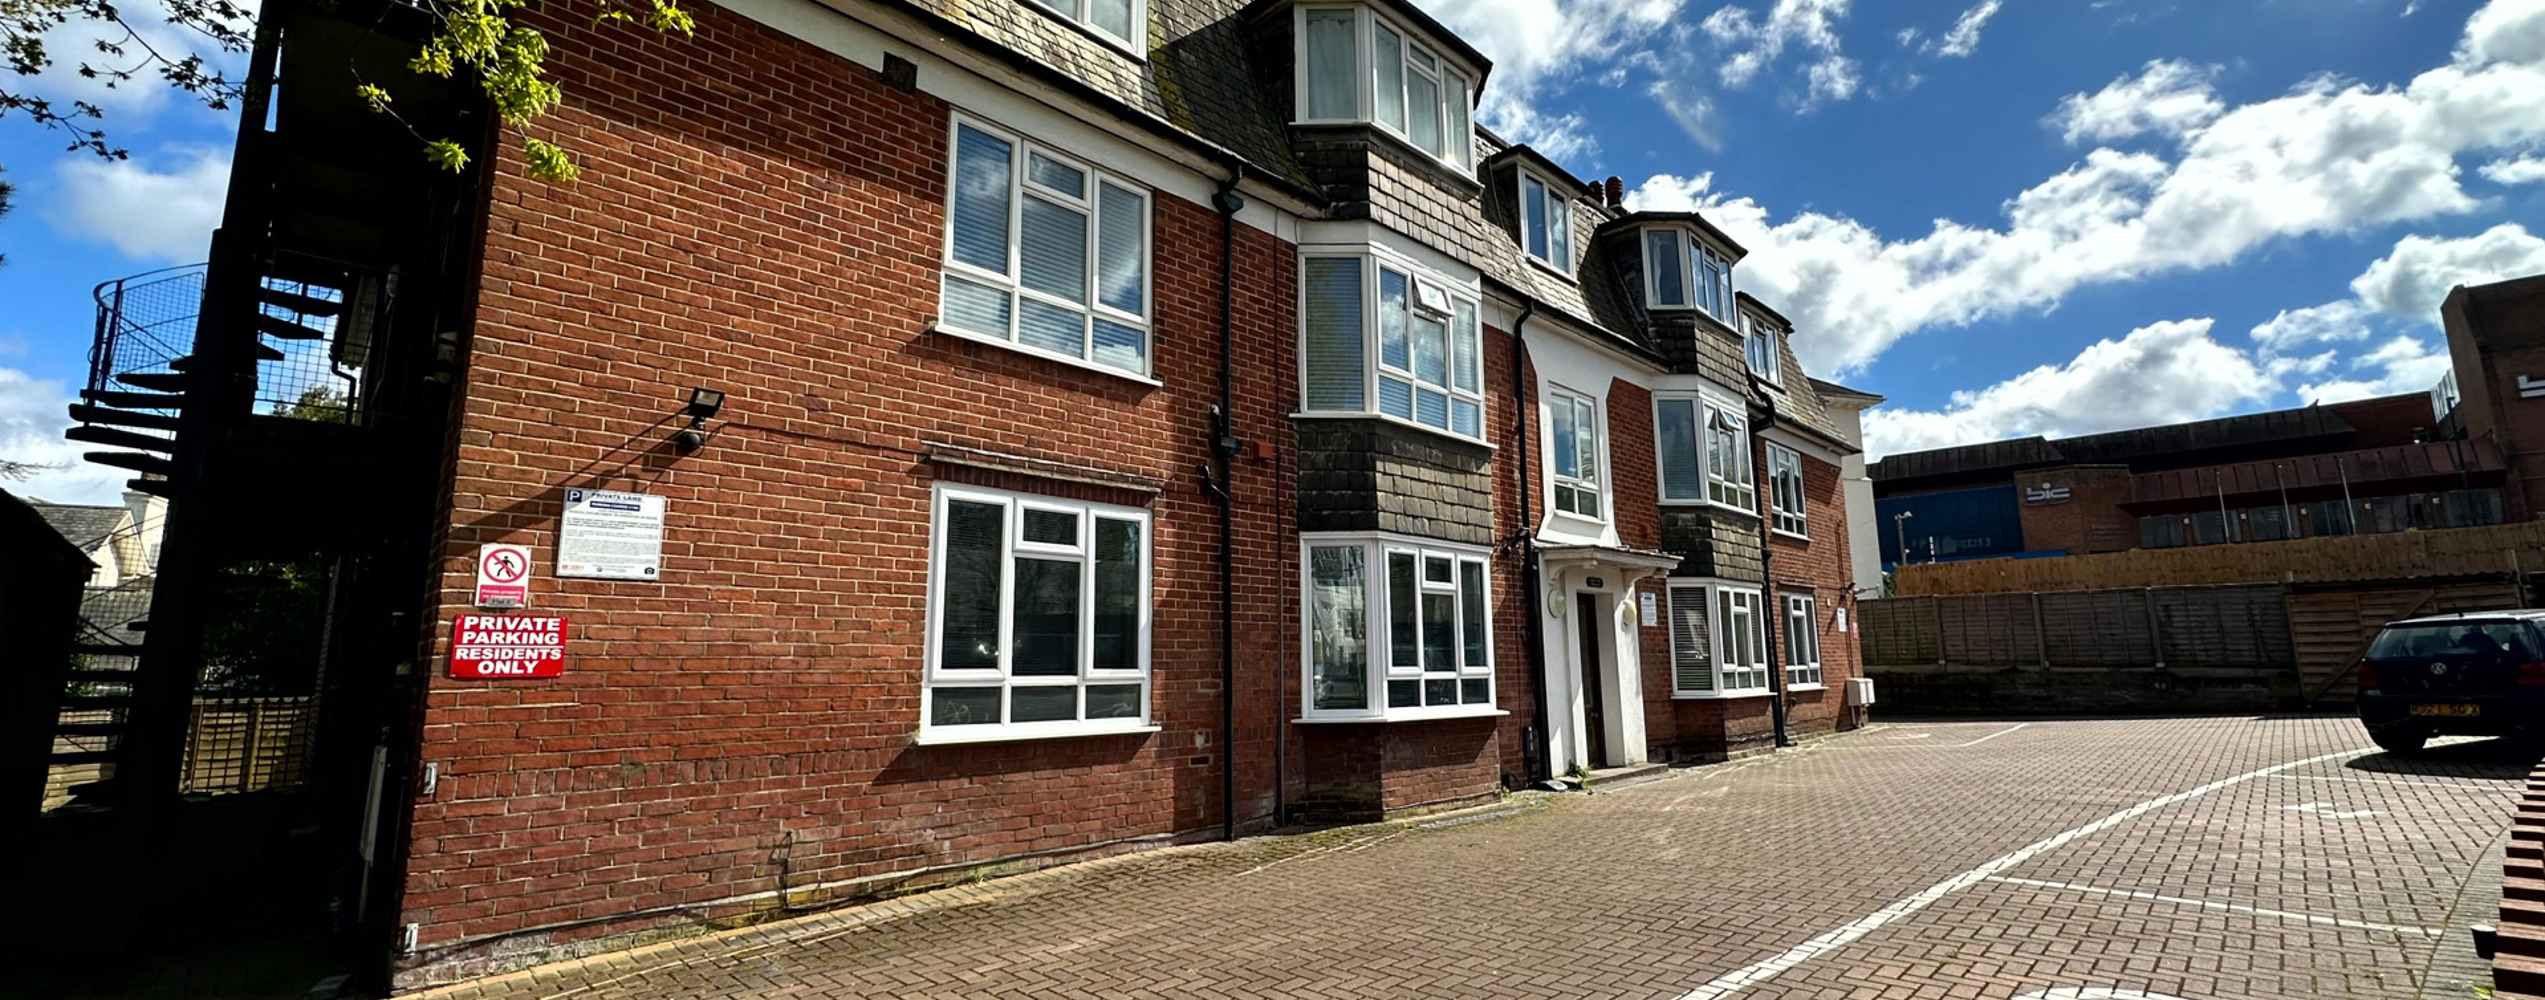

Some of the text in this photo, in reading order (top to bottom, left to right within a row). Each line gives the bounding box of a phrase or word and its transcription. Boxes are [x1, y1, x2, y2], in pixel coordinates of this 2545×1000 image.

[569, 491, 581, 501] P
[591, 492, 621, 501] PRIVATE
[2026, 482, 2071, 501] bic
[463, 616, 562, 631] PRIVATE
[462, 631, 559, 645] PARKING
[455, 648, 562, 660] RESIDENTS
[477, 660, 539, 674] ONLY
